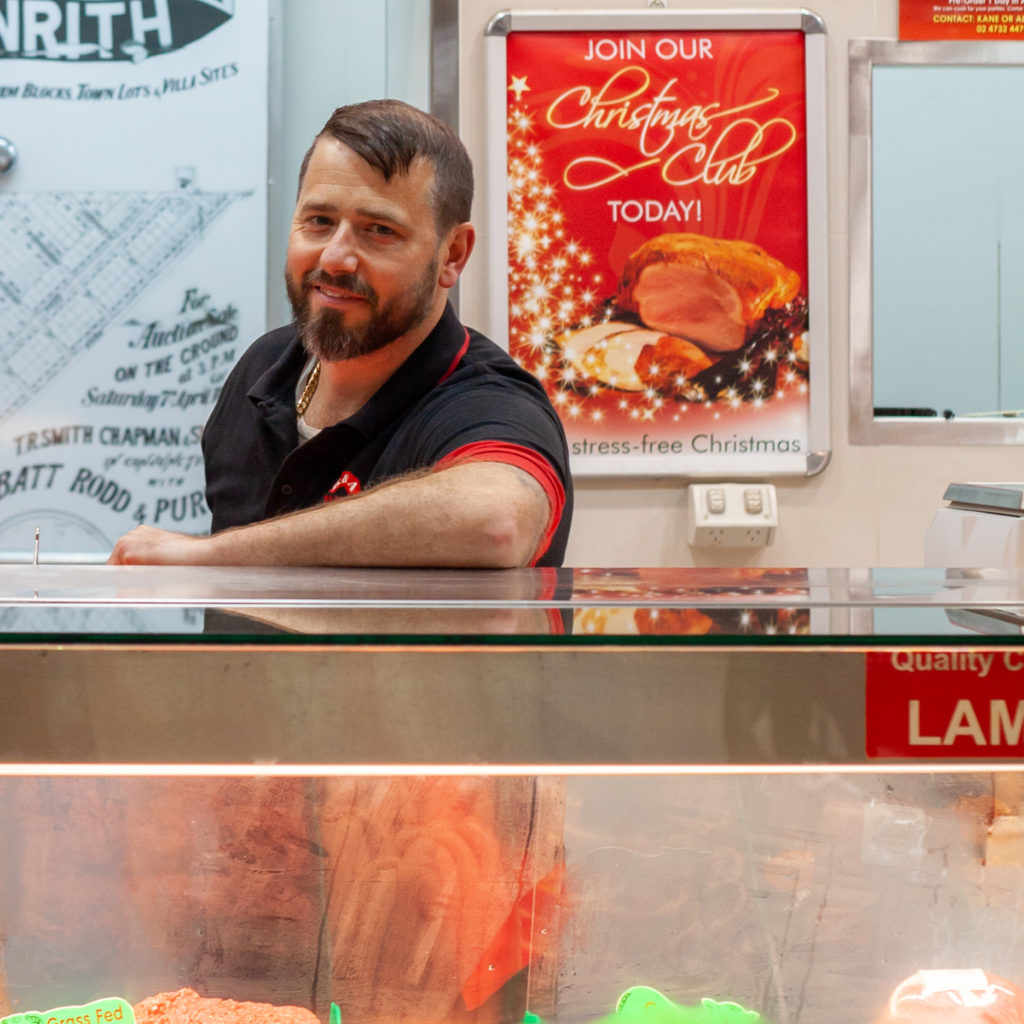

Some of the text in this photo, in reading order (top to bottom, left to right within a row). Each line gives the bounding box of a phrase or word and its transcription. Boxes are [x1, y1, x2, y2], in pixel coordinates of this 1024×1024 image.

[977, 14, 999, 24] KANE
[1001, 14, 1014, 24] OR
[583, 38, 714, 61] JOIN OUR
[547, 65, 780, 157] Christmas
[661, 118, 798, 187] Club
[606, 199, 703, 224] TODAY!
[179, 288, 211, 315] For
[126, 318, 204, 349] Auction
[114, 364, 138, 383] ON
[145, 354, 174, 378] THE
[82, 386, 160, 413] Saturday
[99, 425, 180, 447] CHAPMAN
[571, 432, 802, 458] stress-free Christmas
[69, 467, 133, 514] RODD
[891, 652, 994, 677] Quality
[908, 699, 1024, 746] LAM
[95, 1004, 124, 1023] Fed
